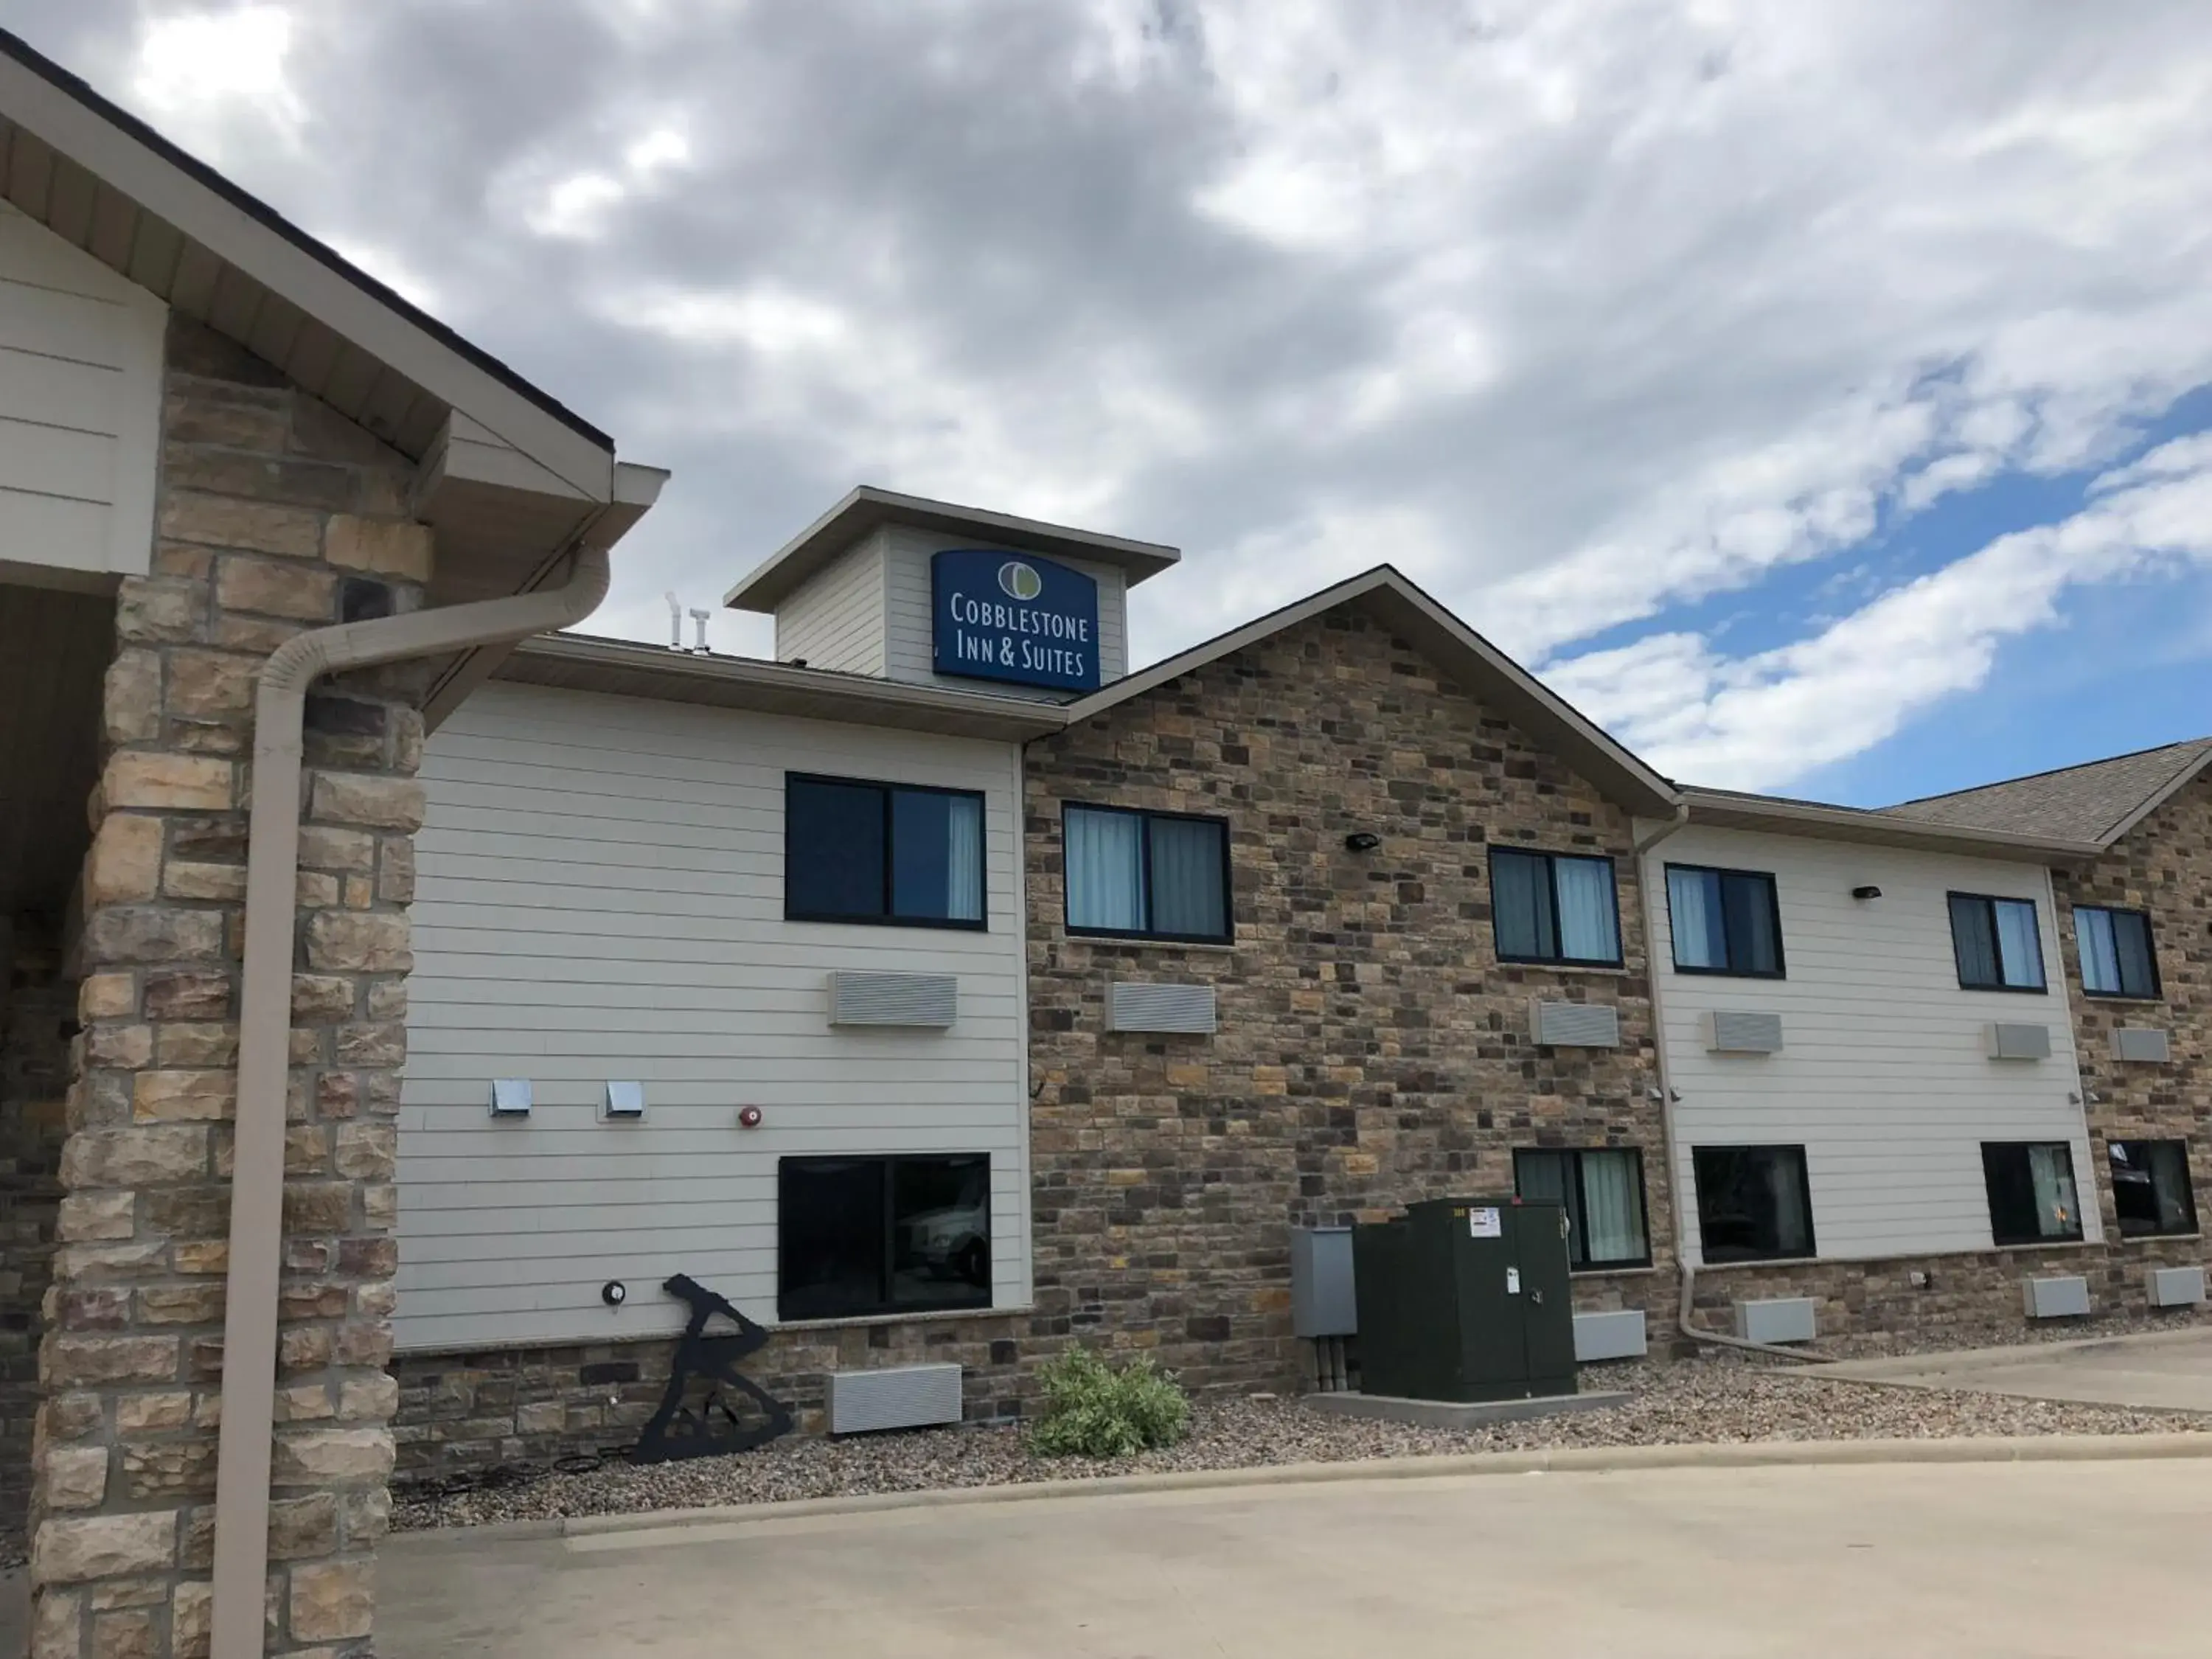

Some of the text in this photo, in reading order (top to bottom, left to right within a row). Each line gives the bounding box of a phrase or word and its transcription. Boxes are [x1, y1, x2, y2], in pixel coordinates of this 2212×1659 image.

[950, 592, 1088, 642] COBBLESTONE
[957, 629, 1084, 677] INN & SUITES
